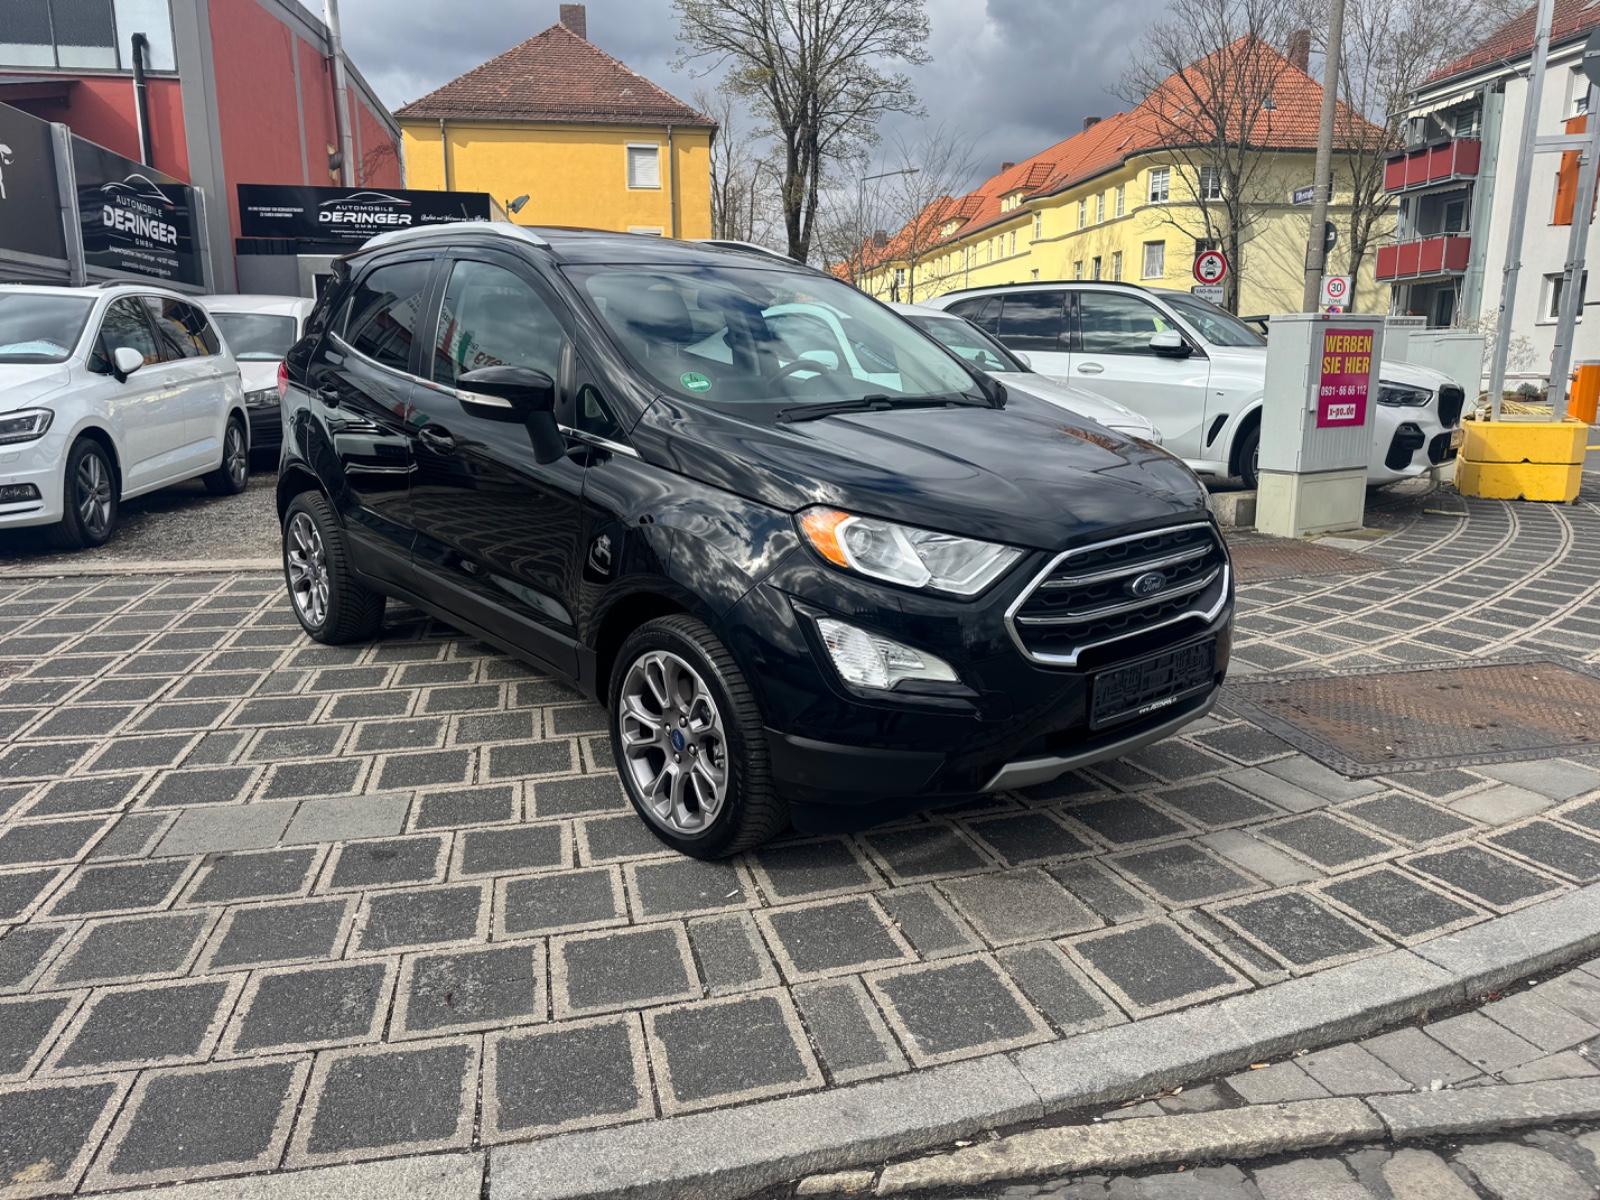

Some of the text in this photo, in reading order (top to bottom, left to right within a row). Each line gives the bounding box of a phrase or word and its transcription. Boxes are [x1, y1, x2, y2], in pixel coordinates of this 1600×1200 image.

[116, 195, 163, 217] AUTOMOBILE
[335, 205, 394, 213] AUTOMOBILE
[103, 204, 177, 246] DERINGER
[319, 211, 413, 225] DERINGER
[1331, 283, 1341, 292] 30
[1325, 335, 1372, 353] WERBEN
[1322, 356, 1370, 374] SIE HIER
[1357, 384, 1368, 395] 112
